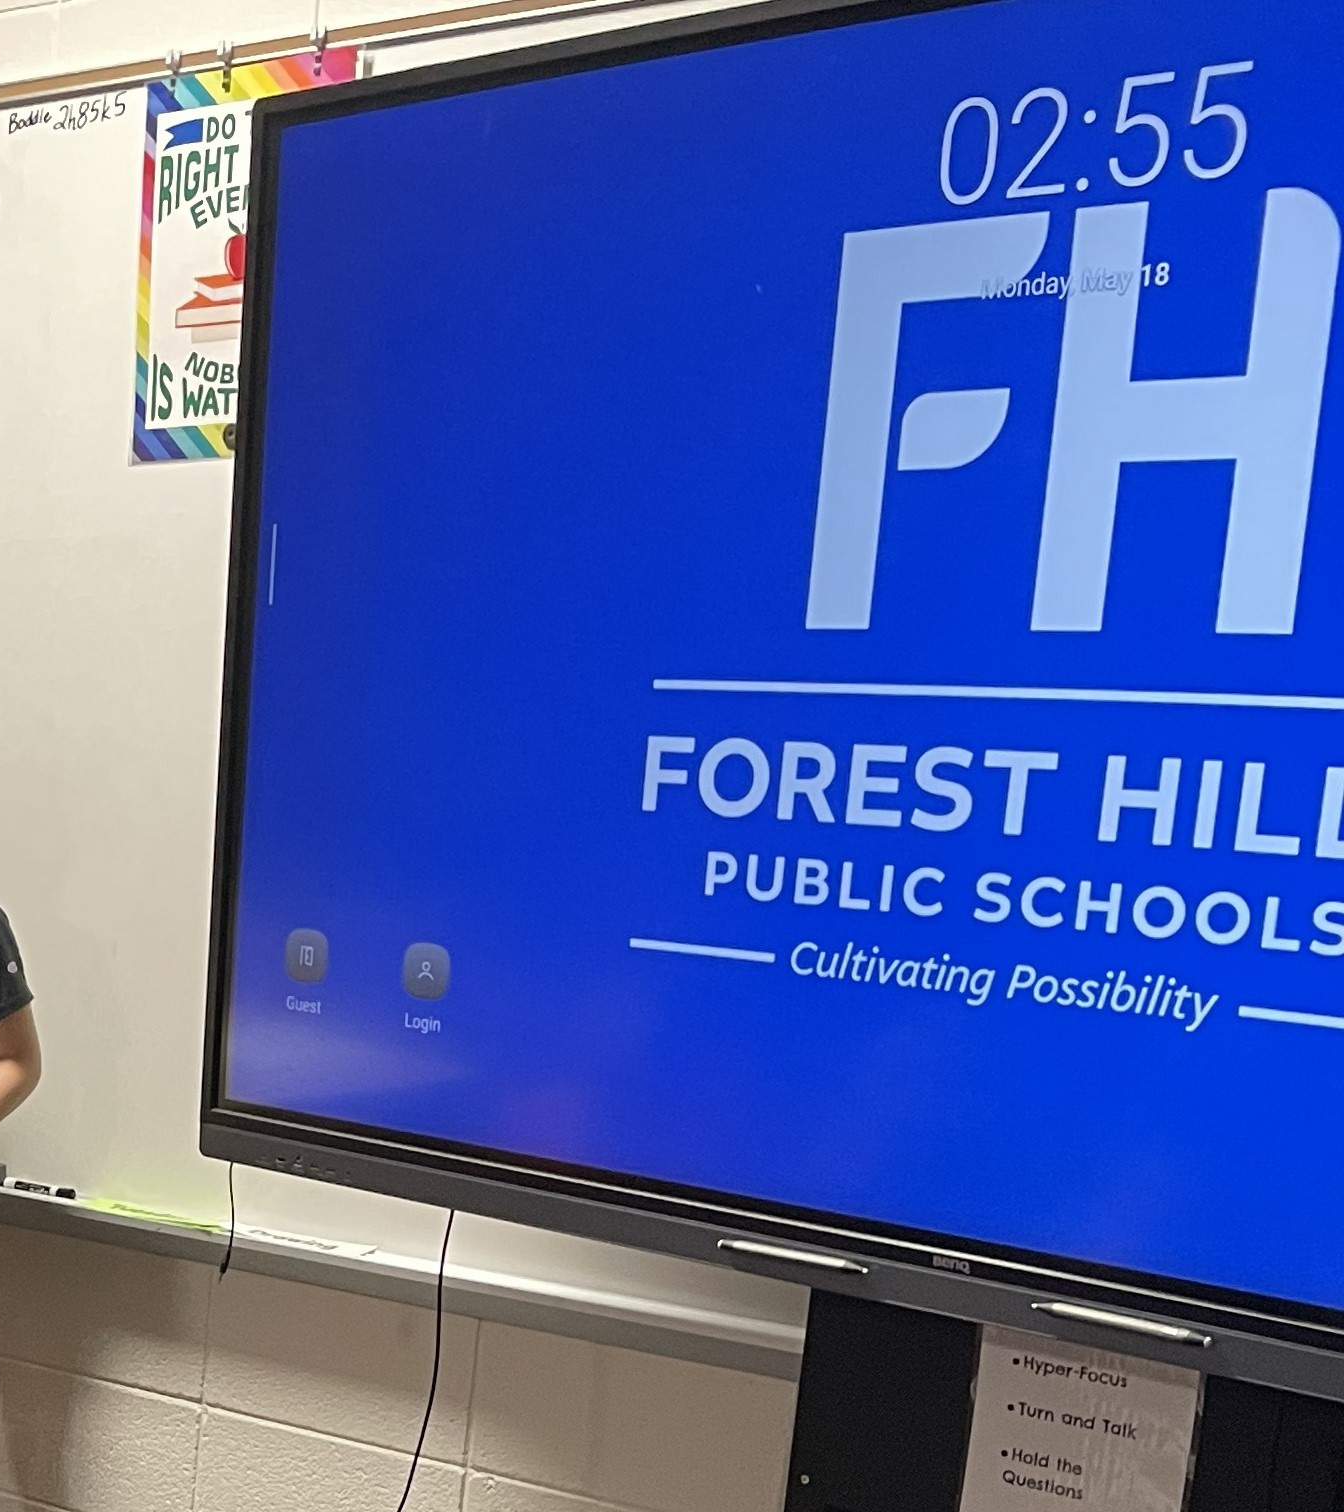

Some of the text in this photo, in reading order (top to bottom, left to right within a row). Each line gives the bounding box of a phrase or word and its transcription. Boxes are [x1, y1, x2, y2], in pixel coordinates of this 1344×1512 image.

[206, 113, 236, 143] DO
[939, 60, 1255, 206] 02:55
[157, 143, 240, 225] RIGHT
[1080, 266, 1133, 296] May
[1140, 261, 1171, 288] 18
[185, 351, 235, 384] NOB
[151, 353, 239, 422] IS WAT
[641, 735, 1060, 836] FOREST
[703, 850, 1344, 957] PUBLIC SCHOOLS
[285, 994, 322, 1015] Guest
[789, 941, 1220, 1033] Cultivating Possibility
[404, 1011, 441, 1034] Login
[1023, 1354, 1128, 1389] Hyper-Focus
[1018, 1401, 1138, 1441] Turn and Talk
[1011, 1447, 1082, 1477] Hold the
[1001, 1469, 1083, 1501] Questions
